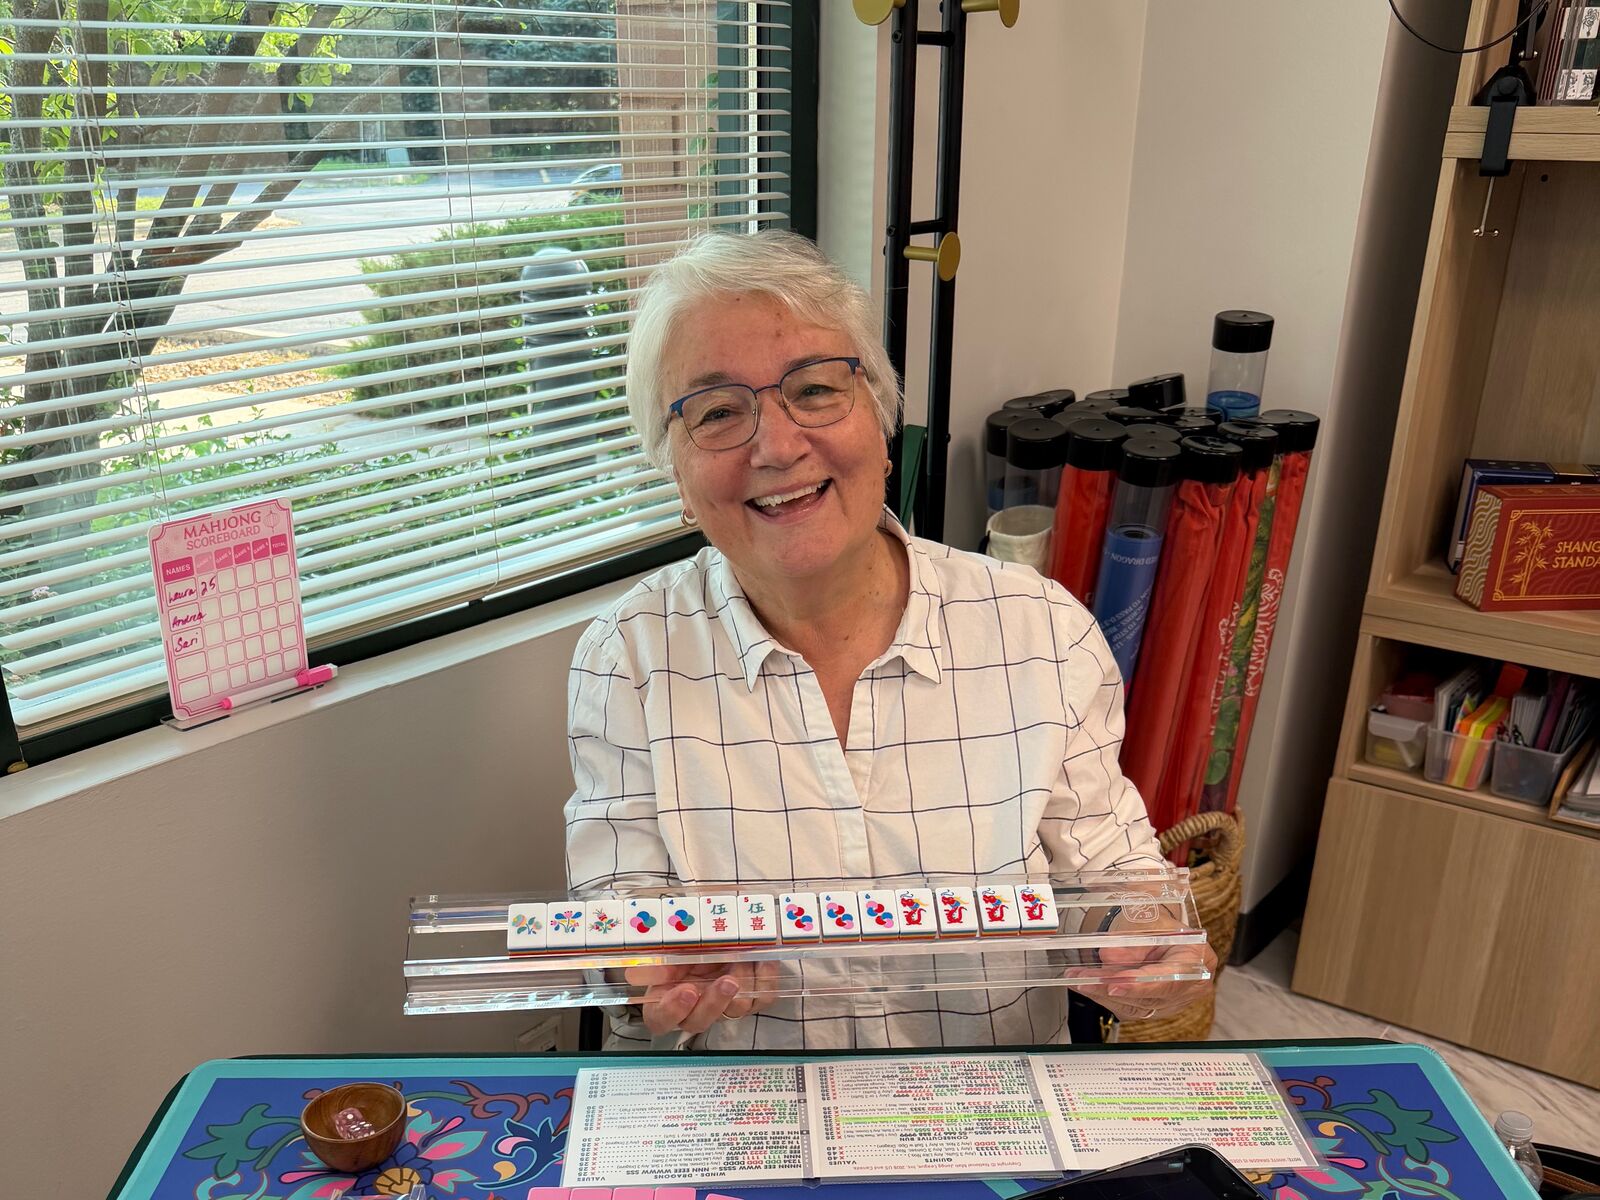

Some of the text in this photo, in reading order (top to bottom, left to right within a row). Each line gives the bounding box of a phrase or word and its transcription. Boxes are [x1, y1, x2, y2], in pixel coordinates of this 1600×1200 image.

[184, 511, 261, 539] MAHJONG
[186, 525, 260, 550] SCOREBOARD
[1111, 552, 1145, 566] DRAGON
[166, 563, 191, 576] NAMES
[172, 612, 206, 628] Andrea
[710, 904, 728, 915] 伍
[748, 902, 765, 913] 伍
